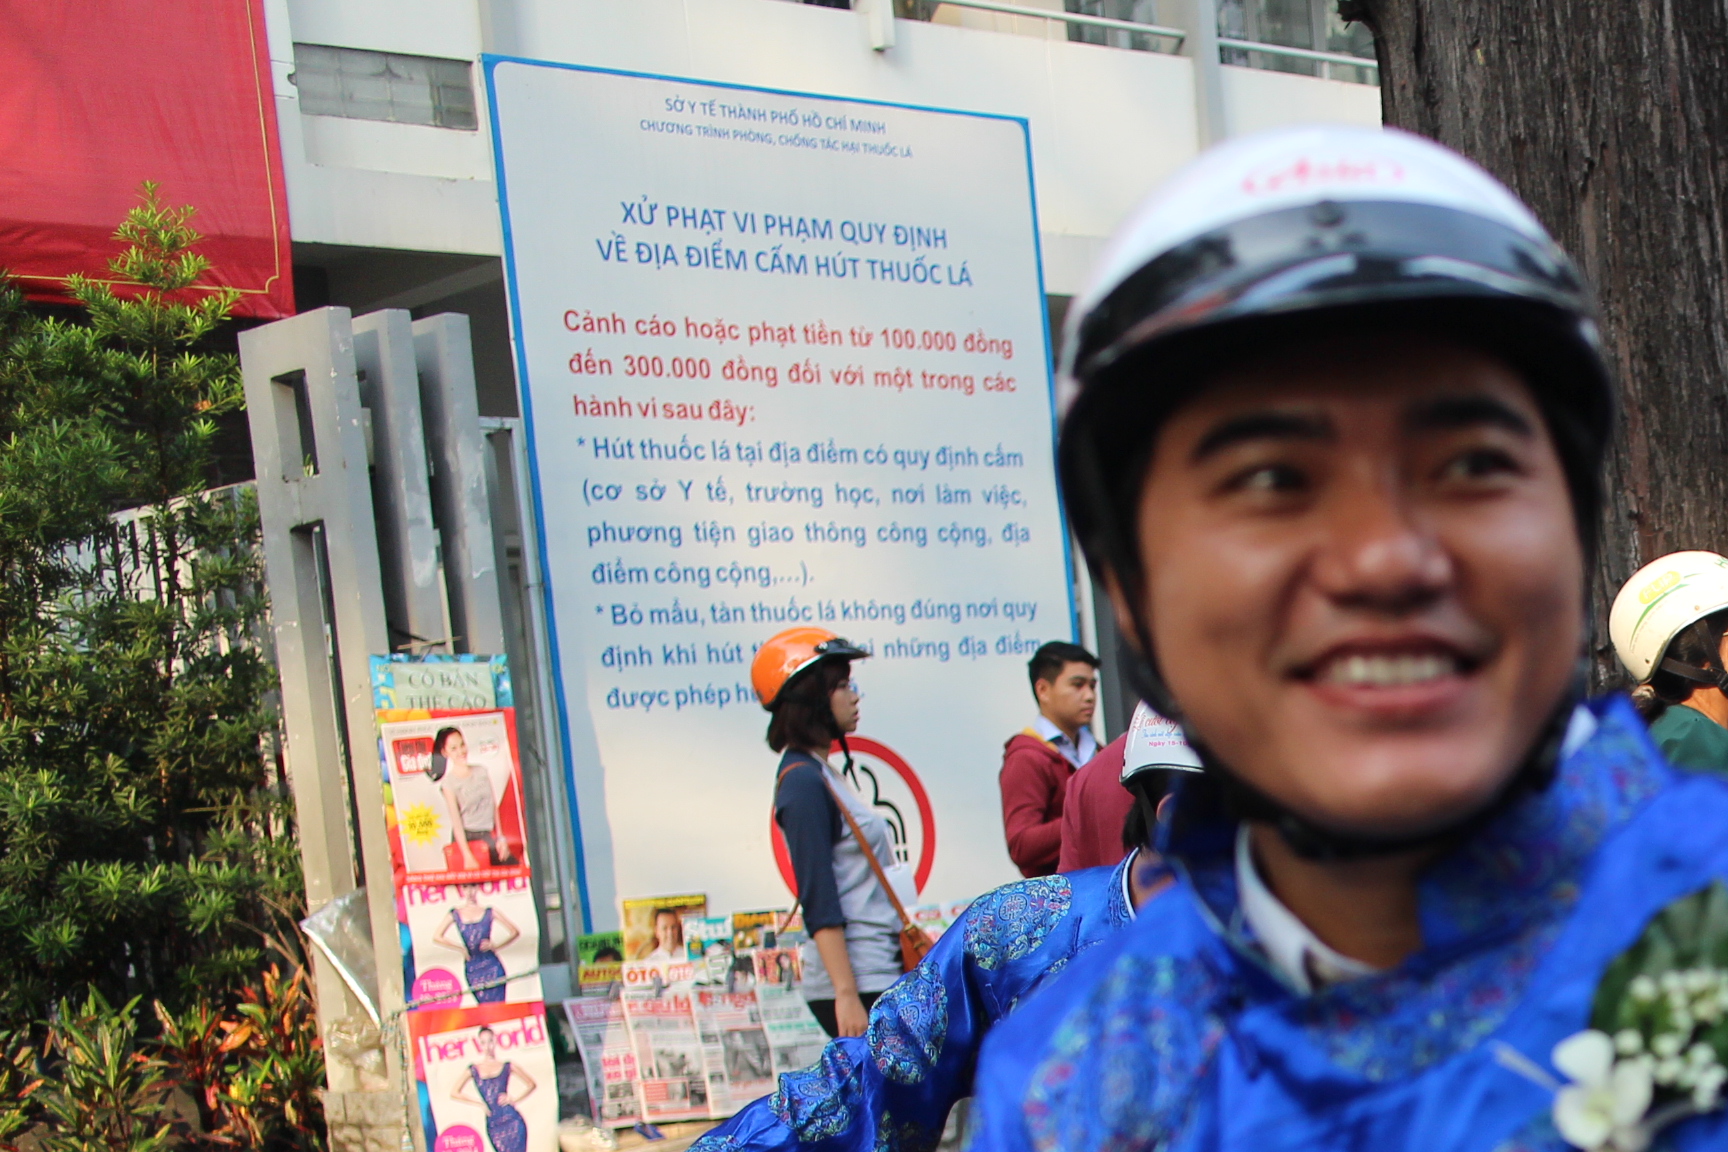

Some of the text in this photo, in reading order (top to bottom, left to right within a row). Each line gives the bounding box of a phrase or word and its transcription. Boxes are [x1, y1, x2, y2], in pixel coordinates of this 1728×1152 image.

[640, 119, 693, 135] CHƯƠNG
[696, 124, 730, 139] TRÌNH
[665, 97, 886, 134] SỞ Y TẾ THÀNH PHỐ HỒ CHÍ MINH
[621, 194, 947, 251] XỬ PHẠT VI PHẠM QUY ĐỊNH
[596, 230, 973, 287] VỀ ĐỊA ĐIỂM CẤM HÚT THUỐC LÁ
[563, 309, 1014, 360] Cảnh cáo hoặc phạt tiền từ 100.000 đồng
[569, 348, 1017, 396] đến 300.000 đồng đối với một trong các
[573, 394, 756, 427] hành vi sau đây:
[593, 436, 635, 460] Hút
[640, 433, 706, 462] thuốc
[711, 439, 731, 462] lá
[736, 441, 763, 467] tại
[768, 442, 801, 468] địa
[806, 437, 859, 465] điểm
[863, 443, 888, 465] có
[893, 448, 930, 471] quy
[935, 445, 979, 471] định
[983, 442, 1024, 467] cấm
[582, 475, 1028, 509] (cơ sở Y tế, trường học, nơi làm việc,
[587, 520, 1031, 548] phương tiện giao thông công cộng, địa
[591, 556, 649, 584] điểm
[654, 560, 711, 588] công
[611, 602, 644, 626] Bỏ
[710, 601, 745, 623] tàn
[750, 596, 812, 623] thuốc
[818, 600, 836, 622] lá
[841, 600, 906, 625] không
[910, 599, 962, 625] đúng
[966, 598, 998, 618] nơi
[1003, 601, 1037, 623] quy
[601, 643, 653, 672] định
[662, 642, 697, 666] khi
[706, 641, 744, 665] hút
[884, 638, 950, 662] những
[958, 636, 987, 660] địa
[996, 630, 1042, 656] điểm
[606, 688, 669, 713] được
[675, 683, 731, 710] phép
[426, 1034, 469, 1063] her
